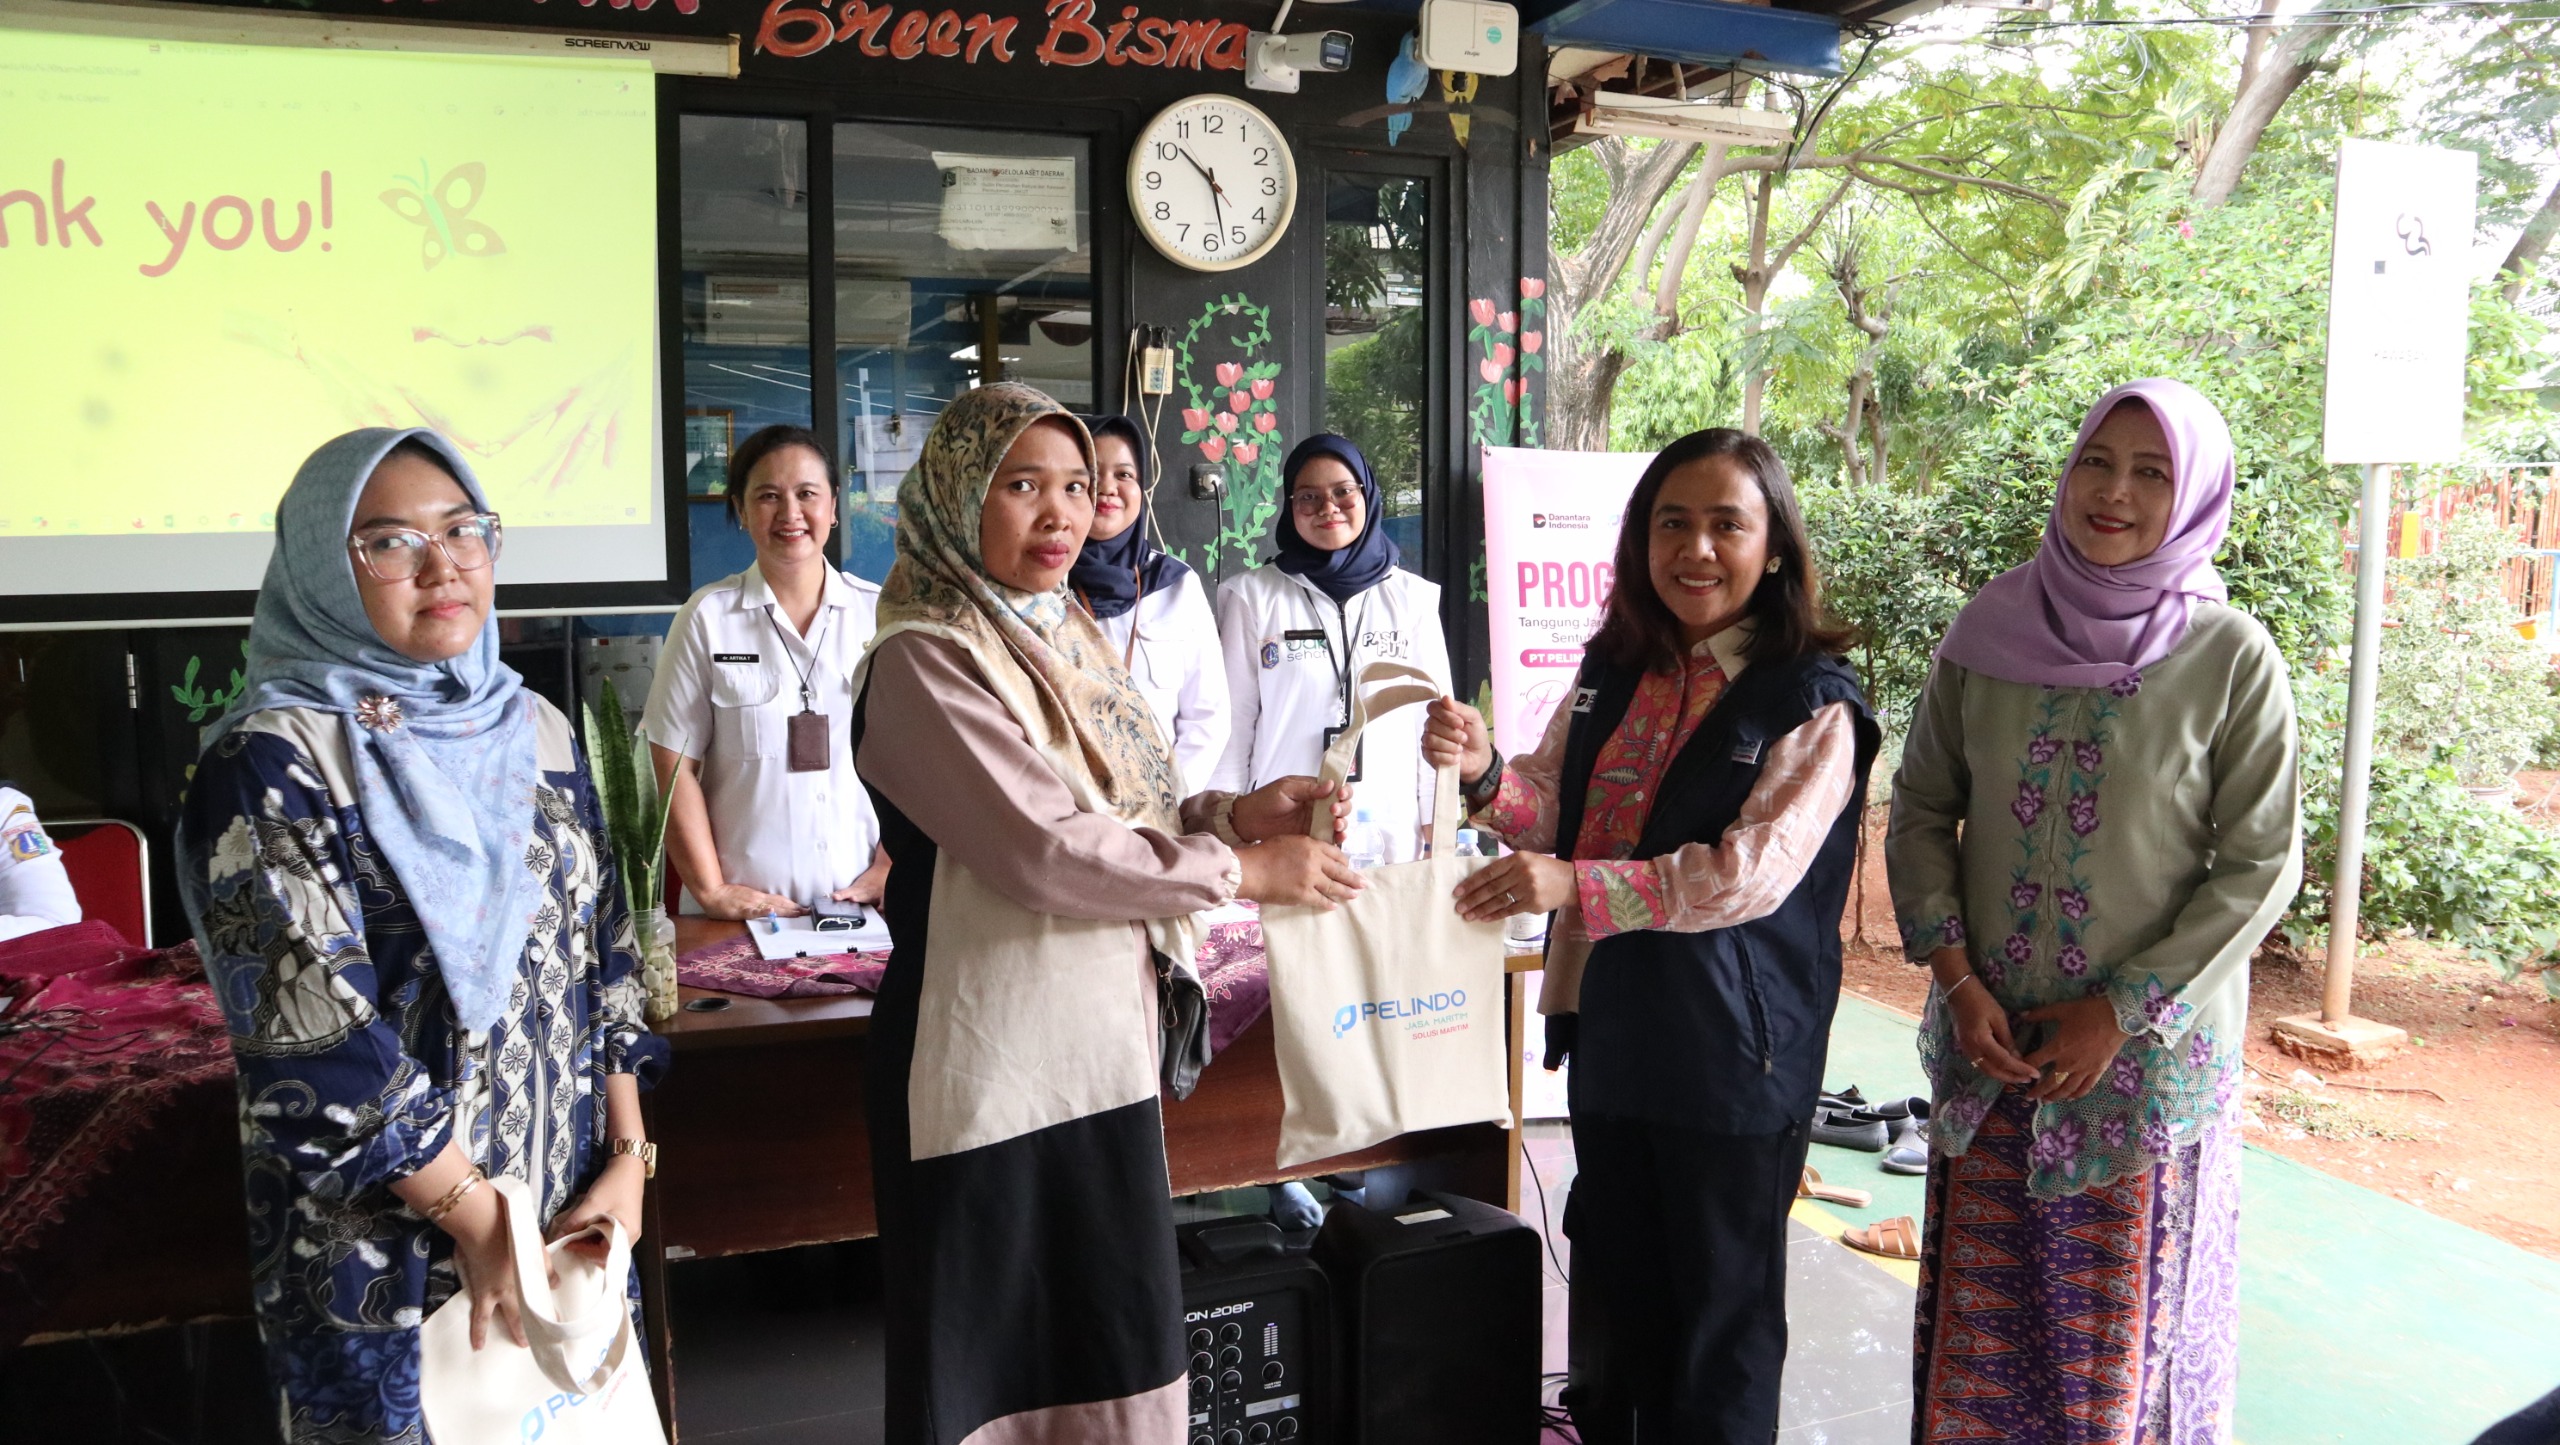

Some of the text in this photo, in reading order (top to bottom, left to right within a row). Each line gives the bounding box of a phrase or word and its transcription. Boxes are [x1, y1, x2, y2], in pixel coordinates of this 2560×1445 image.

[753, 0, 1249, 70] Green Bisma
[1177, 120, 1189, 139] 11
[1202, 115, 1223, 134] 12
[1240, 124, 1246, 143] 1
[1155, 141, 1178, 160] 10
[1253, 147, 1268, 166] 2
[1146, 171, 1162, 190] 9
[1261, 177, 1276, 196] 3
[1155, 201, 1170, 220] 8
[1252, 206, 1267, 225] 4
[139, 170, 333, 278] you!
[1176, 223, 1191, 242] 7
[1203, 233, 1219, 252] 6
[1231, 225, 1247, 244] 5
[1548, 513, 1591, 521] Danantara
[1519, 617, 1580, 629] Tanggung
[1287, 650, 1328, 662] sehat
[1528, 653, 1545, 663] PT
[1361, 989, 1467, 1021] PELINDO
[1404, 1012, 1469, 1031] JASA MARITIM
[1412, 1023, 1469, 1040] SOLUSI MARITIM
[1184, 1301, 1254, 1323] ON 208P
